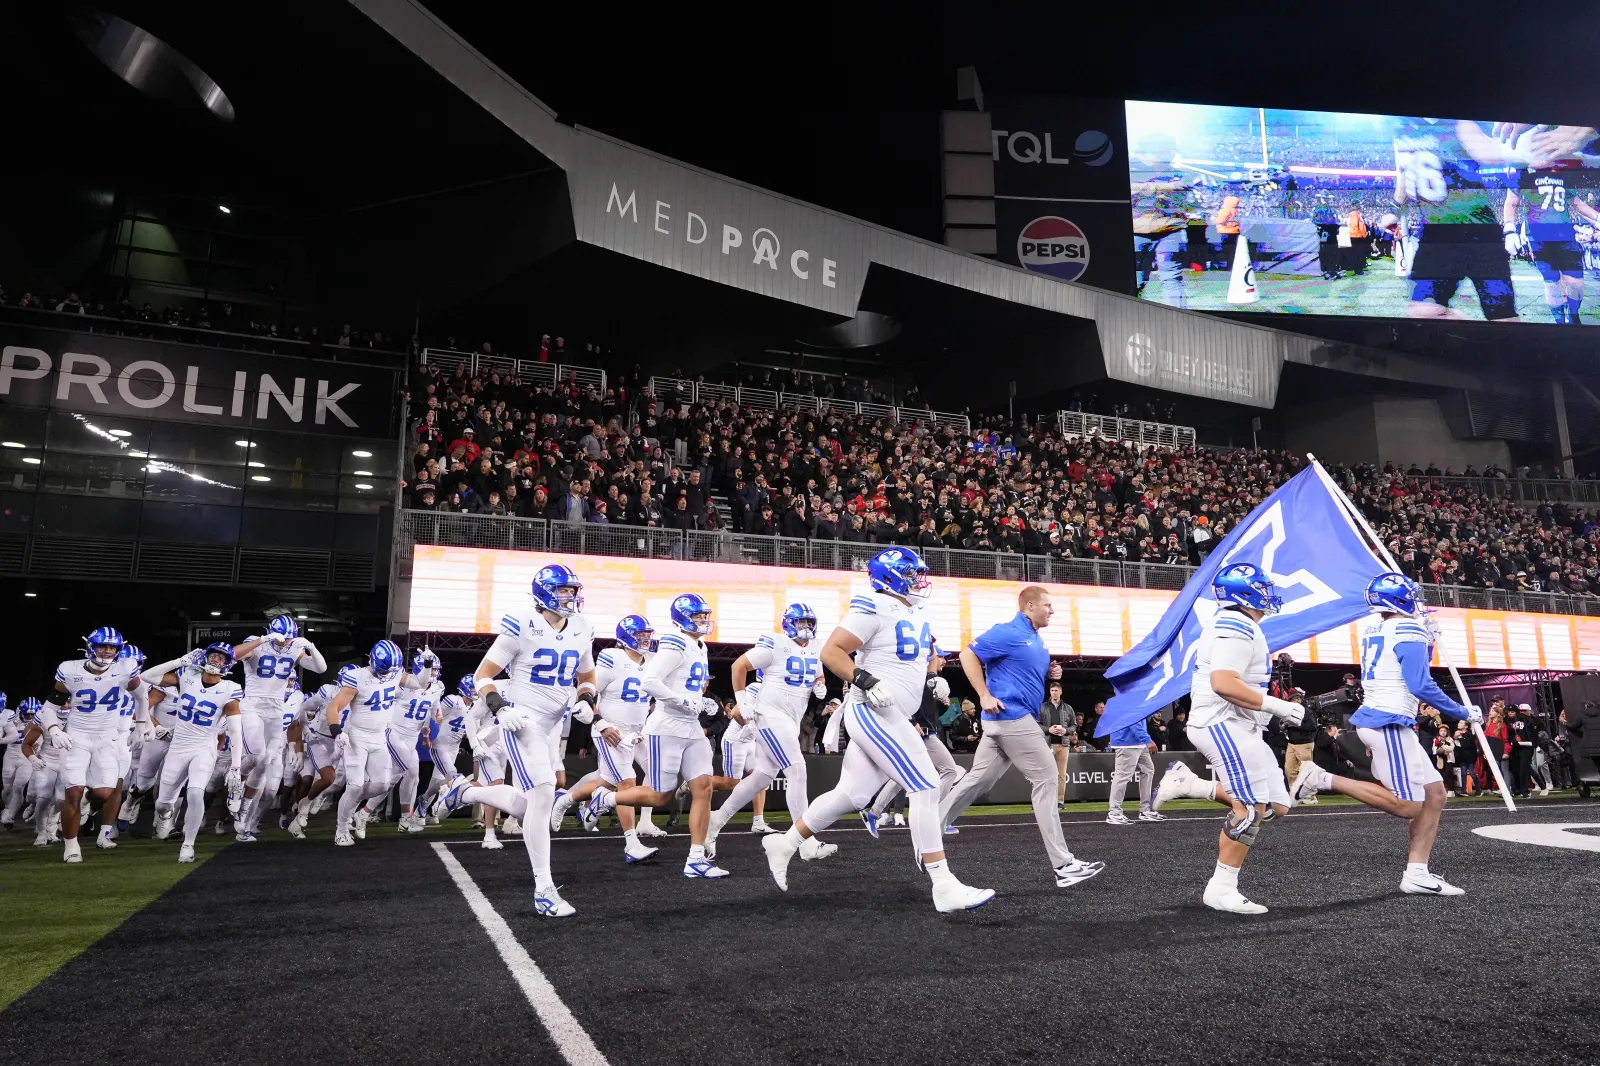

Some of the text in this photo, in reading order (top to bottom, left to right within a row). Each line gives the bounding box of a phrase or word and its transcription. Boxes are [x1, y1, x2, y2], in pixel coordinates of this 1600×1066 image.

[992, 130, 1069, 165] TQL
[606, 181, 837, 289] MEDPACE
[1022, 242, 1086, 259] PEPSI
[0, 346, 362, 429] PROLINK
[895, 619, 932, 662] 64
[256, 654, 295, 680] 83
[529, 647, 580, 687] 20
[784, 655, 819, 688] 95
[75, 686, 120, 713] 34
[177, 692, 218, 727] 32
[363, 686, 396, 711] 45
[404, 698, 432, 721] 16
[1072, 771, 1109, 784] LEVEL
